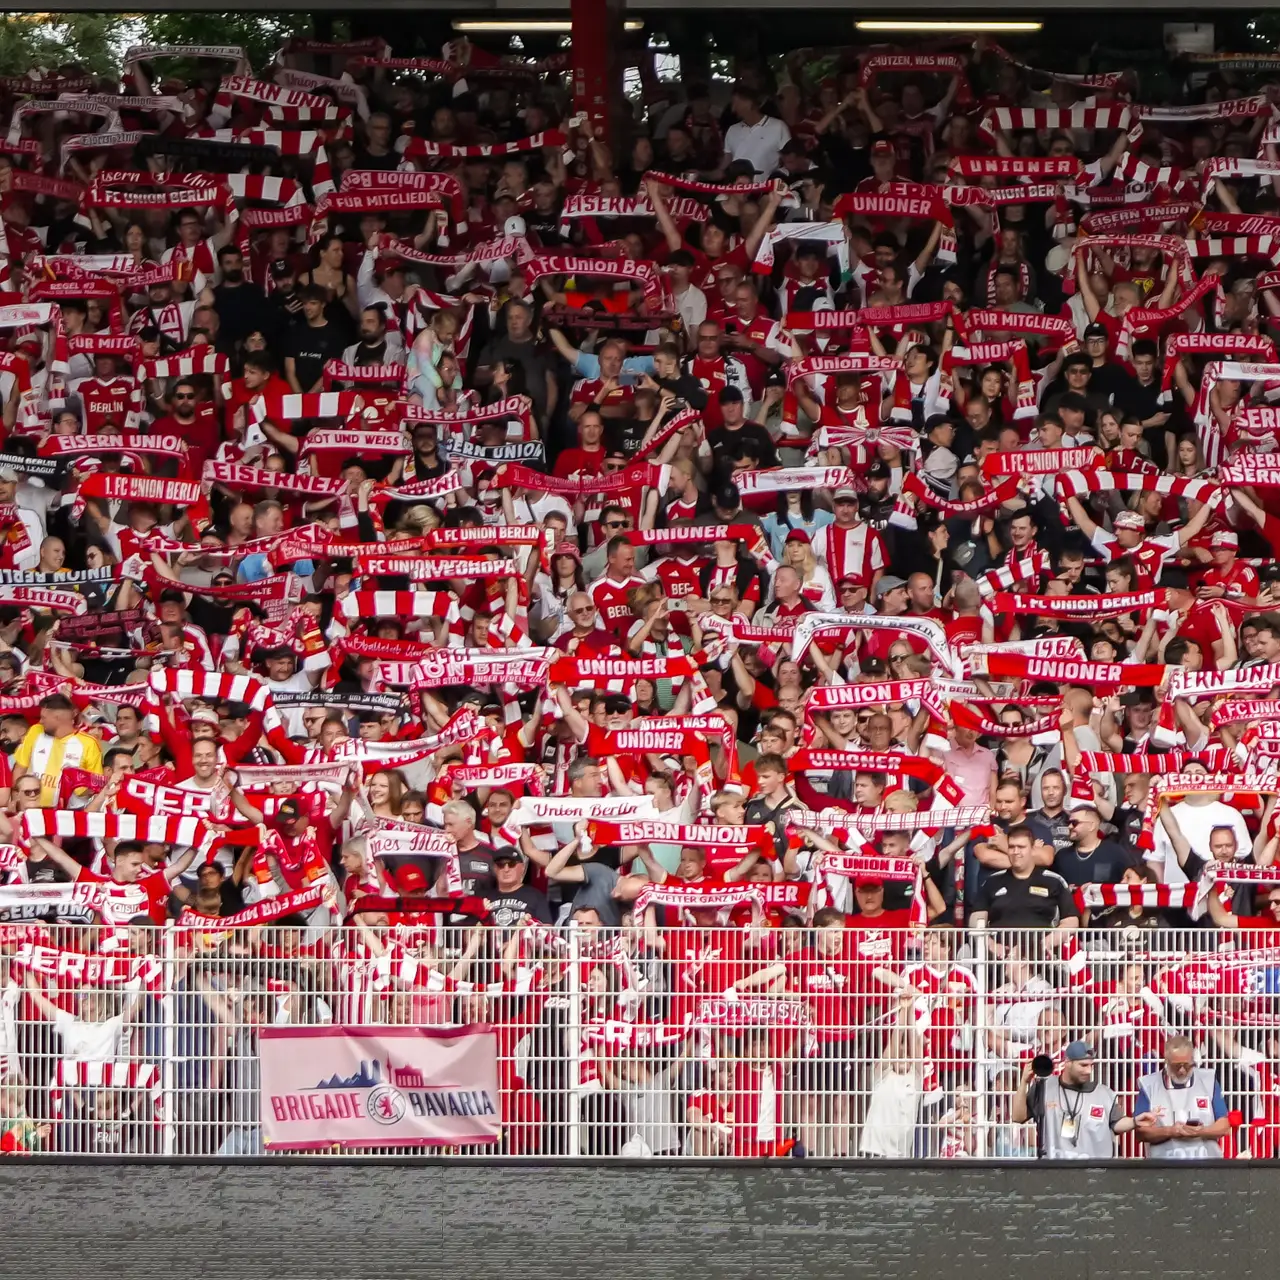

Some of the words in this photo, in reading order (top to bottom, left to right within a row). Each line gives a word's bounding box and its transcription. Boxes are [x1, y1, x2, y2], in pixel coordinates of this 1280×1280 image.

[1218, 97, 1258, 114] 1966
[969, 158, 1071, 174] UNIONER
[90, 190, 102, 203] 1.
[105, 190, 120, 204] FC
[123, 191, 165, 203] UNION
[168, 186, 218, 203] BERLIN
[853, 196, 930, 215] UNIONER
[89, 400, 123, 413] BERLIN
[59, 434, 124, 447] EISERN
[335, 434, 359, 445] UND
[366, 435, 400, 446] WEISS
[1025, 452, 1059, 470] UNION
[130, 479, 165, 498] UNION
[434, 529, 443, 541] 1.
[445, 528, 459, 541] FC
[462, 527, 495, 540] UNION
[499, 526, 539, 538] BERLIN
[643, 527, 726, 540] UNIONER
[1050, 598, 1098, 610] UNION
[1101, 592, 1155, 609] BERLIN
[579, 659, 667, 675] UNIONER
[1028, 660, 1120, 681] UNIONER
[826, 683, 884, 703] UNION
[1227, 702, 1244, 714] FC
[617, 733, 684, 749] UNIONER
[809, 754, 900, 768] UNIONER
[533, 802, 583, 818] Union
[588, 801, 638, 818] Berlin
[617, 822, 679, 840] EISERN
[683, 825, 748, 843] UNION
[271, 1093, 365, 1121] BRIGADE
[411, 1091, 495, 1118] BAVARIA
